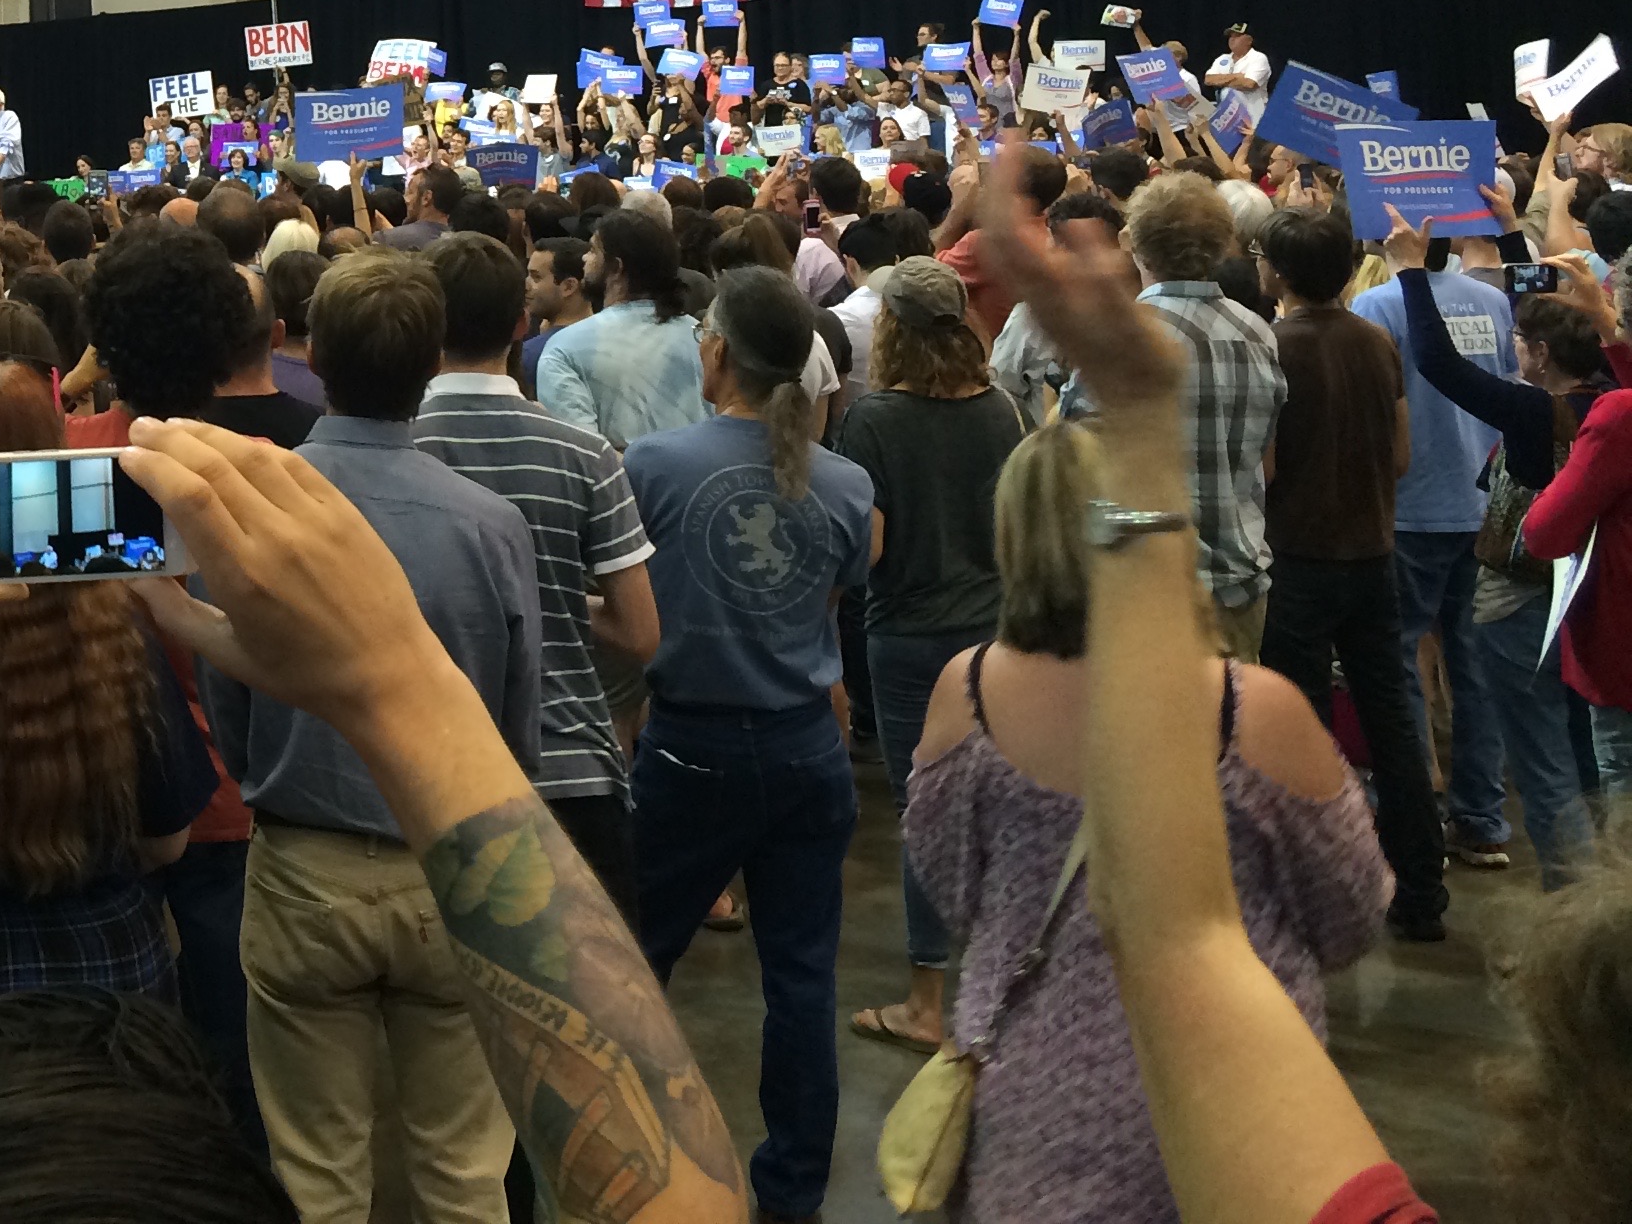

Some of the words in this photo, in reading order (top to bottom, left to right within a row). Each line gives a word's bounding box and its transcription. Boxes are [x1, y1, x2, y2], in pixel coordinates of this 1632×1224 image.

[247, 22, 310, 57] BERN
[376, 42, 428, 61] FEEL
[1061, 45, 1099, 56] Bernie
[151, 73, 208, 102] FEEL
[1037, 72, 1084, 90] Bernie
[166, 96, 199, 114] THE
[311, 97, 391, 122] Bernie
[475, 148, 528, 166] Bernie
[1359, 136, 1471, 172] Bernie
[1384, 187, 1402, 195] FOR
